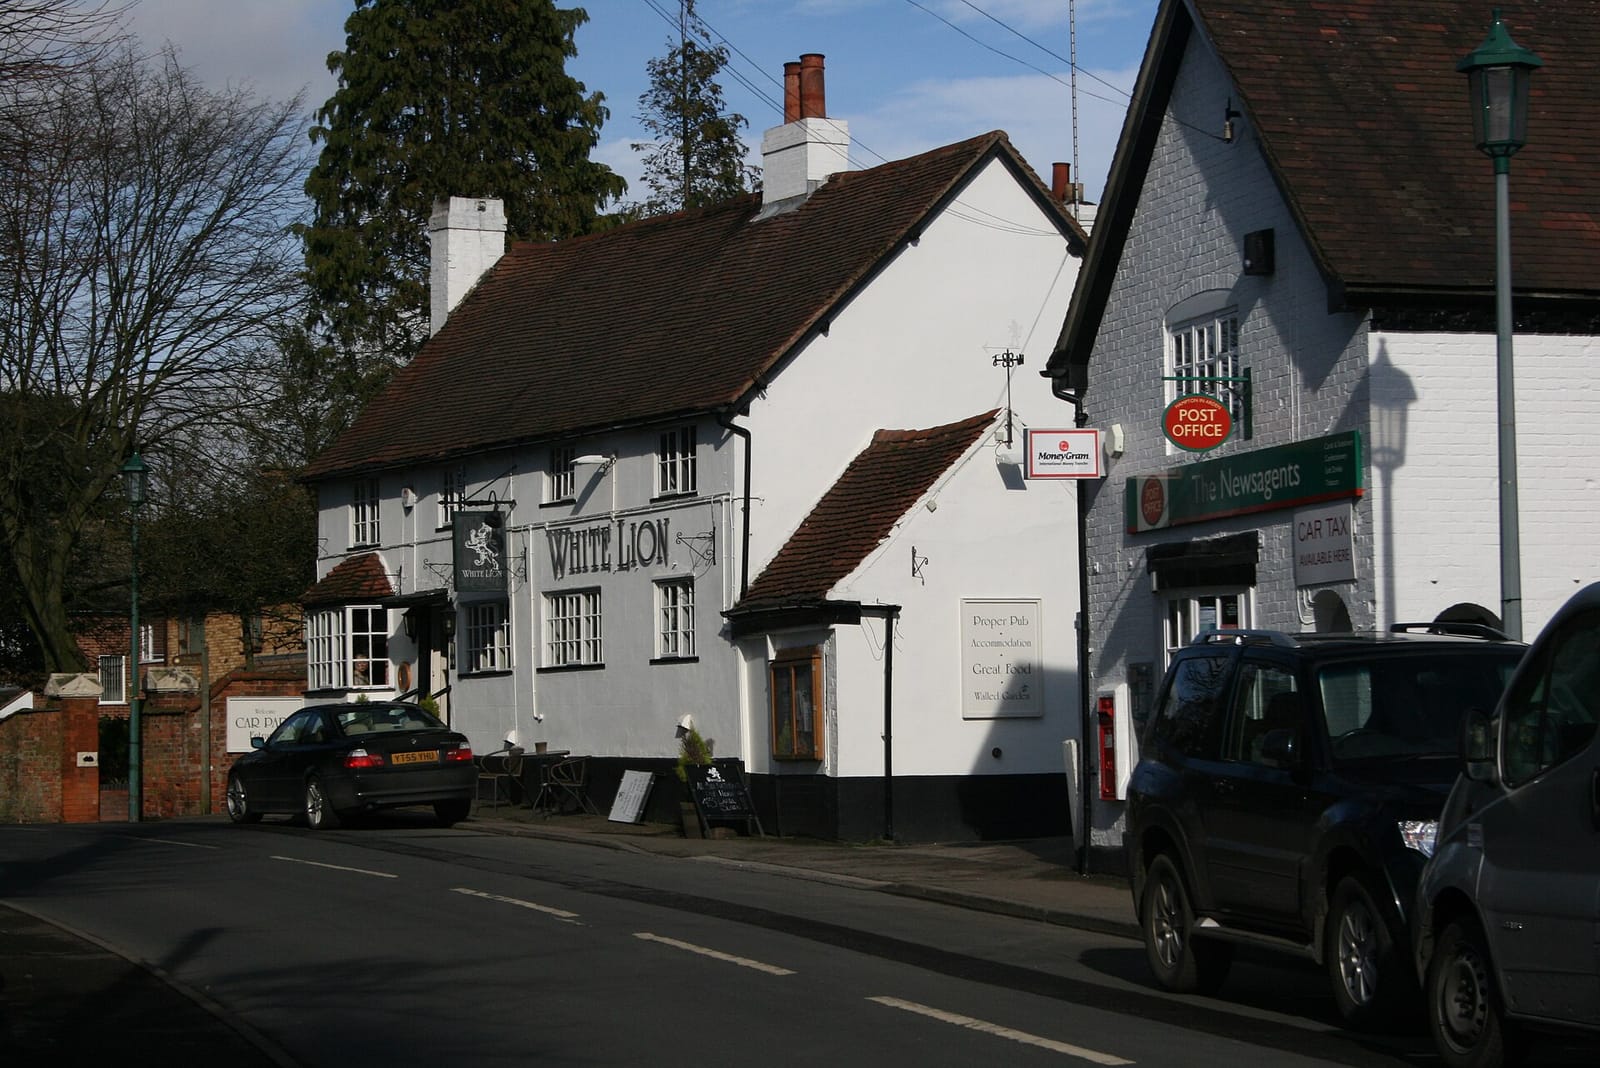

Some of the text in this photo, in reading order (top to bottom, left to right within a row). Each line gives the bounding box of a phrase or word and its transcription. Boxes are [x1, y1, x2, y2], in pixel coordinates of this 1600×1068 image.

[1179, 409, 1217, 421] POST
[1172, 424, 1223, 437] OFFICE
[1038, 452, 1089, 462] MoneyGram
[1191, 463, 1301, 504] The Newsagents
[1145, 487, 1160, 501] POST
[1144, 501, 1162, 513] OFFICE
[1298, 516, 1348, 542] CAR TAX
[545, 518, 670, 581] WHITE LION
[1300, 548, 1350, 566] AVAILABLE HERE
[462, 569, 503, 578] WHITE LION
[973, 615, 1029, 629] Proper Pub
[971, 638, 1032, 648] Accommodation
[972, 663, 1031, 675] Great Food
[974, 691, 1031, 701] Walled Garden
[235, 717, 287, 728] CAR PAR
